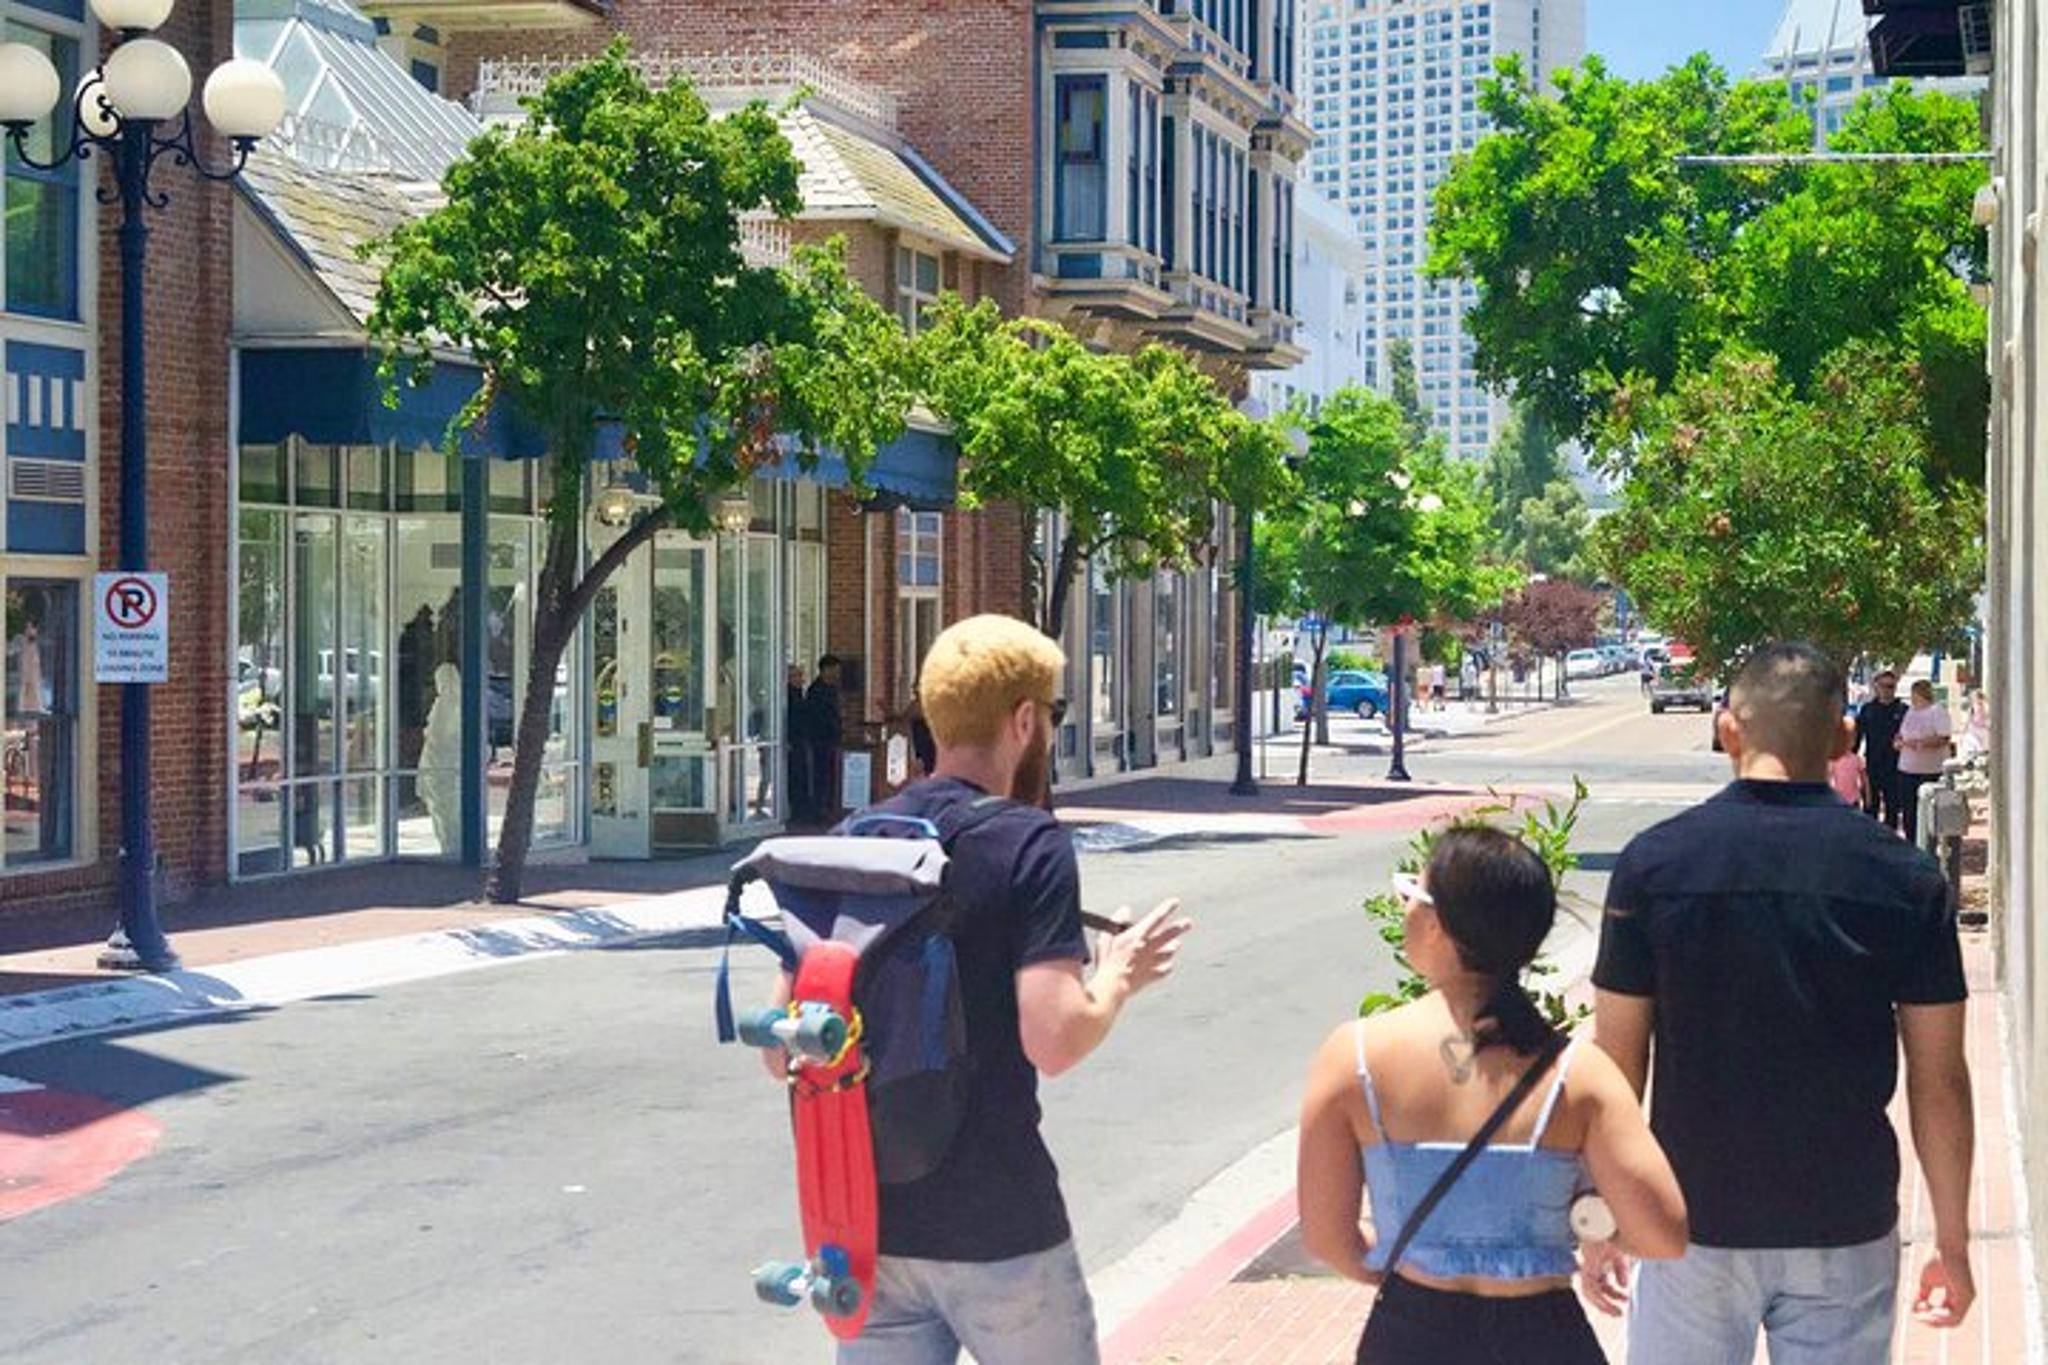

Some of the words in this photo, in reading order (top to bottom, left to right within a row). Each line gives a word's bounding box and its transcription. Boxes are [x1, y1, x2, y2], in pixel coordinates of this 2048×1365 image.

[102, 632, 117, 641] NO
[119, 632, 160, 641] PARKING
[96, 663, 137, 673] LOADING
[139, 663, 163, 673] ZONE
